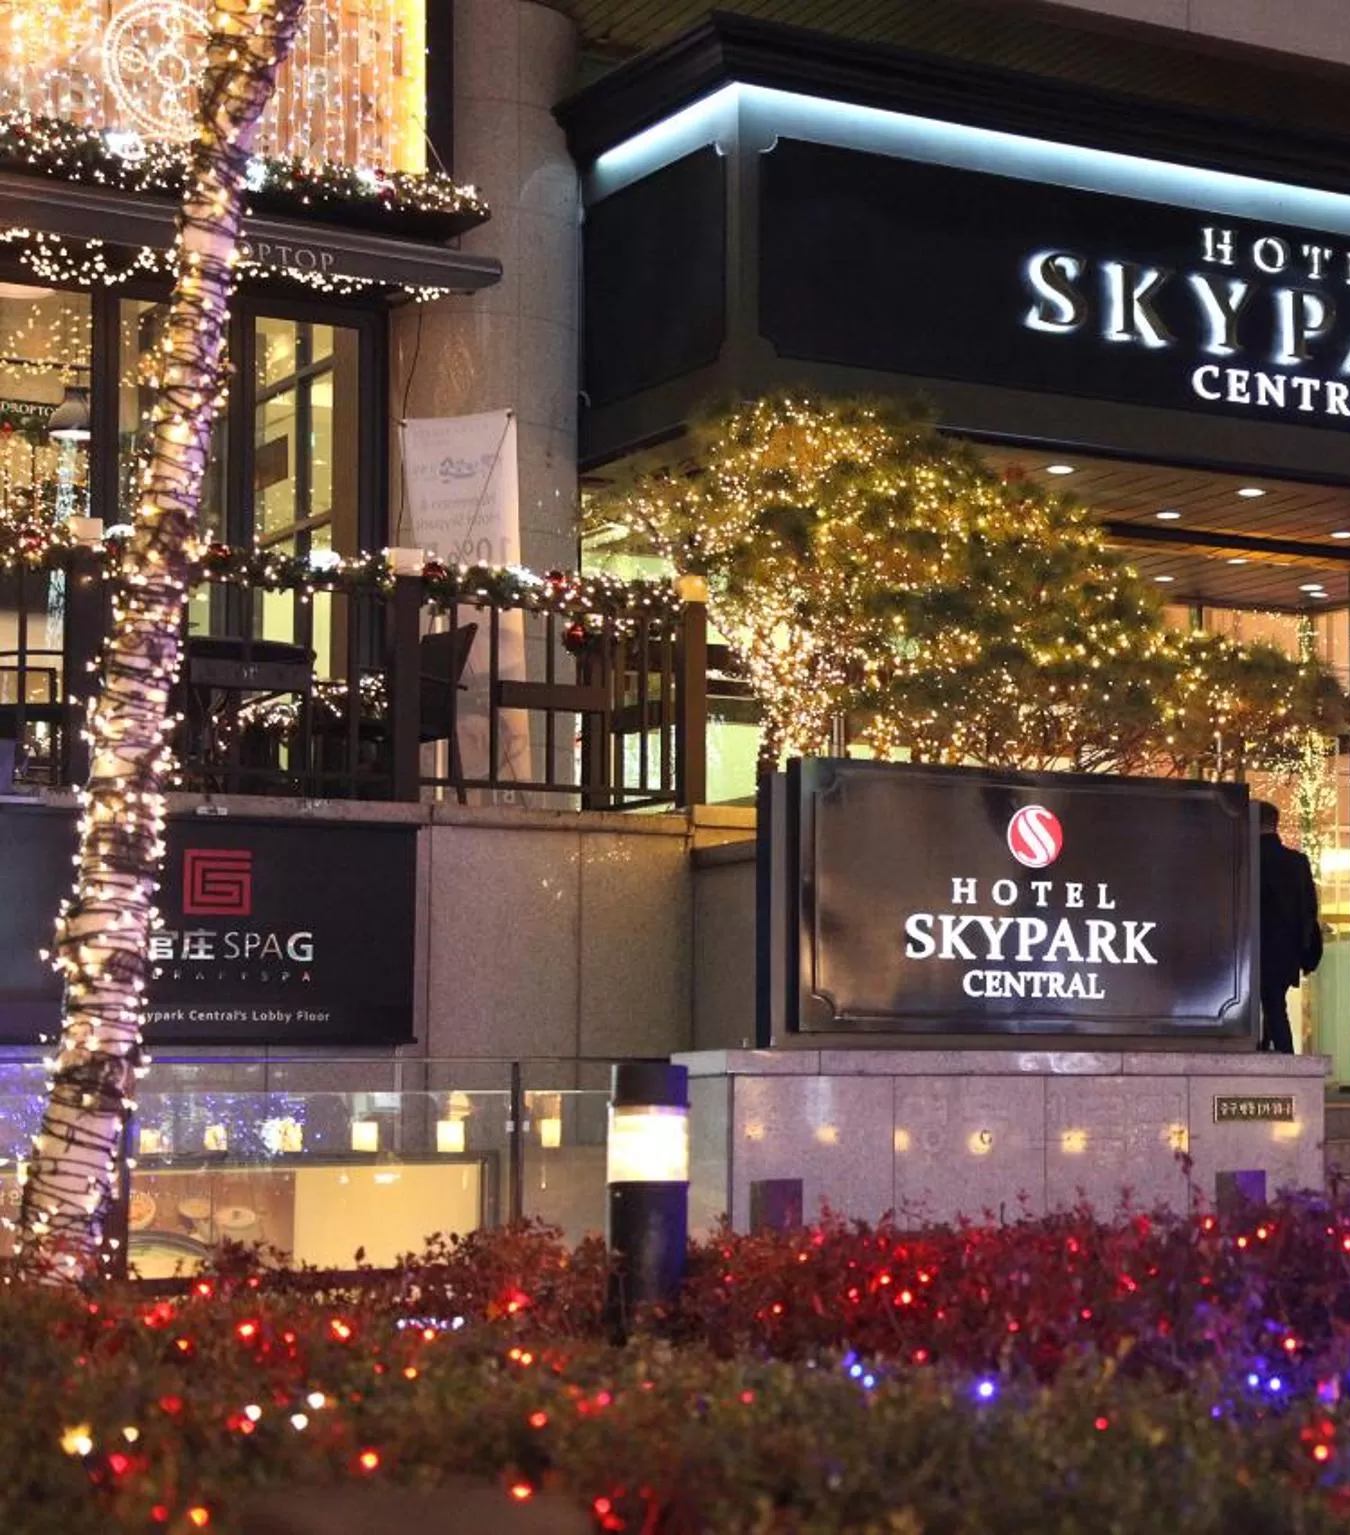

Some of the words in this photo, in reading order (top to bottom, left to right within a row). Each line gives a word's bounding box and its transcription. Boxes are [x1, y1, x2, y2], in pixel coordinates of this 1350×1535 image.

[239, 240, 334, 272] OPTOP
[951, 877, 1116, 910] HOTEL
[905, 913, 1158, 964] SKYPARK
[962, 969, 1105, 999] CENTRAL
[188, 1009, 248, 1022] Central's
[252, 1010, 292, 1024] Lobby
[296, 1010, 330, 1022] Floor
